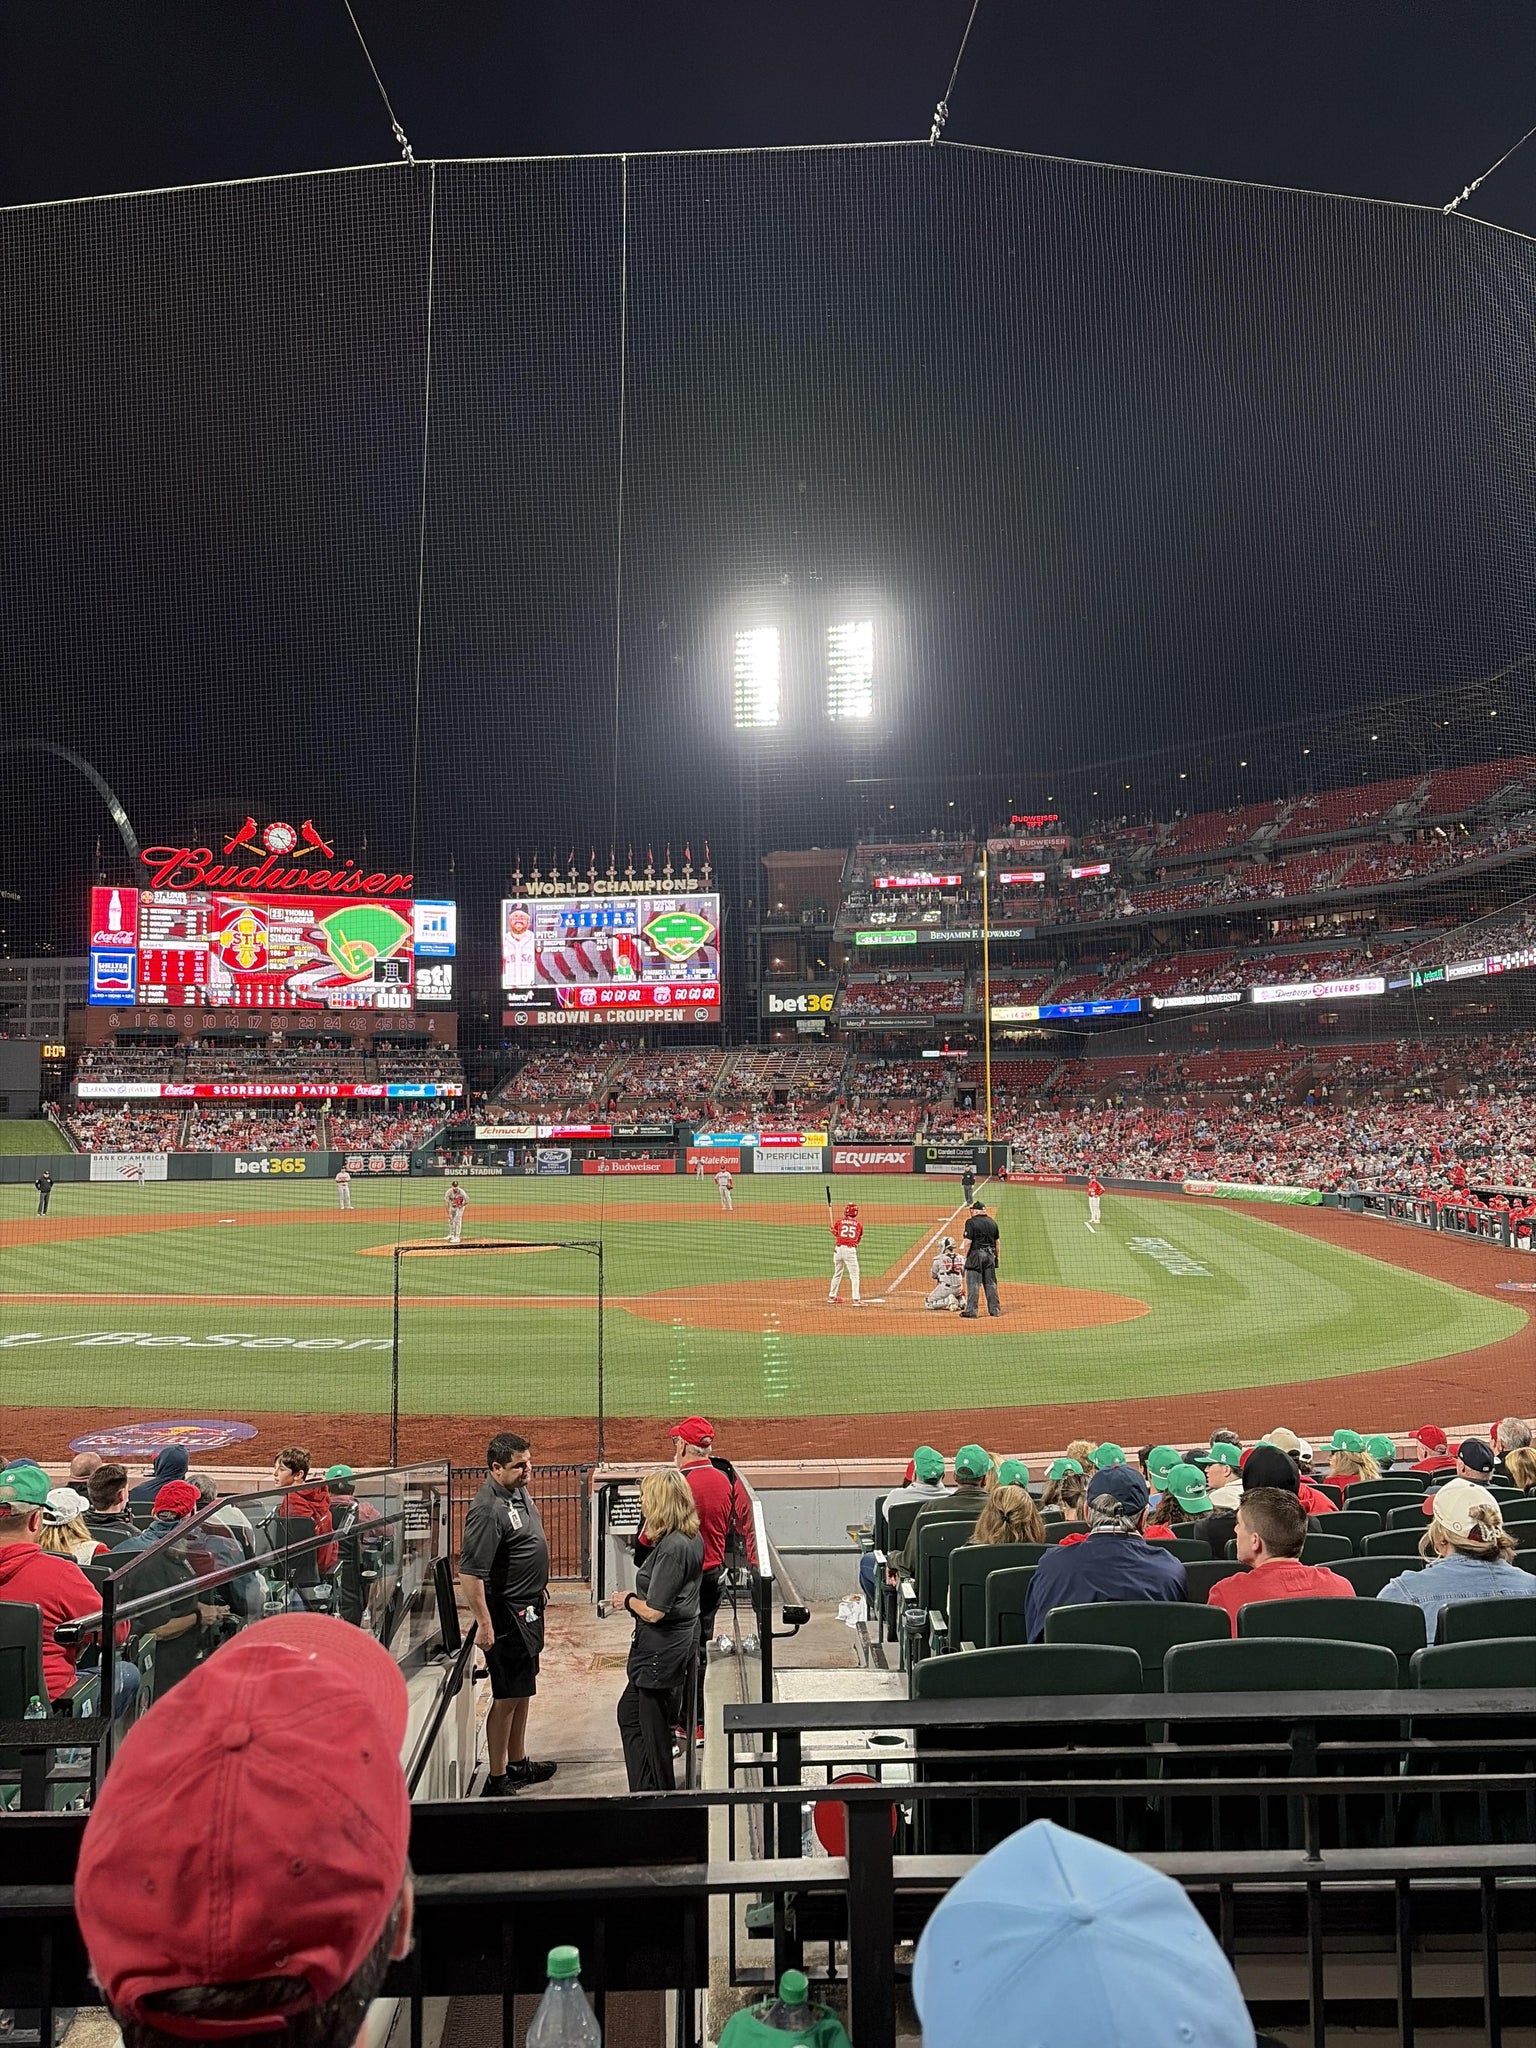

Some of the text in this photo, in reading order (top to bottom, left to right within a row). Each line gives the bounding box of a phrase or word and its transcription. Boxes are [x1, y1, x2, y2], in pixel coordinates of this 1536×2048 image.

[1011, 814, 1058, 823] BUDWEISER
[1020, 839, 1065, 847] BUDWEISER
[141, 846, 414, 894] Budweiser
[526, 879, 699, 895] WORLD CHAMPIONS
[270, 934, 300, 943] SINGLE
[930, 931, 971, 940] BENJAMIN
[972, 930, 979, 938] F.
[416, 964, 453, 986] stl
[417, 986, 453, 994] TODAY
[1206, 993, 1242, 1004] UNIVERSITY
[538, 1011, 590, 1024] BROWN
[595, 1013, 604, 1023] &
[607, 1010, 683, 1023] CROUPPEN
[135, 1014, 141, 1027] 1
[148, 1014, 159, 1027] 2
[166, 1014, 175, 1027] 6
[184, 1015, 194, 1027] 9
[202, 1015, 216, 1028] 10
[225, 1015, 240, 1028] 14
[248, 1015, 262, 1029] 17
[271, 1016, 288, 1029] 20
[298, 1016, 316, 1030] 23
[323, 1016, 341, 1030] 24
[349, 1017, 367, 1031] 42
[376, 1017, 393, 1031] 45
[846, 1020, 862, 1028] Mercy
[213, 1085, 298, 1095] SCOREBOARD
[302, 1085, 339, 1095] PATIO
[481, 1126, 531, 1135] Schnucks
[543, 1151, 564, 1162] Ford
[766, 1152, 819, 1161] PERFICIENT
[834, 1151, 906, 1168] EQUIFAX
[235, 1158, 306, 1175] bet365
[612, 1162, 661, 1172] Budweiser
[445, 1168, 468, 1176] BUSCH
[841, 1225, 857, 1239] 25
